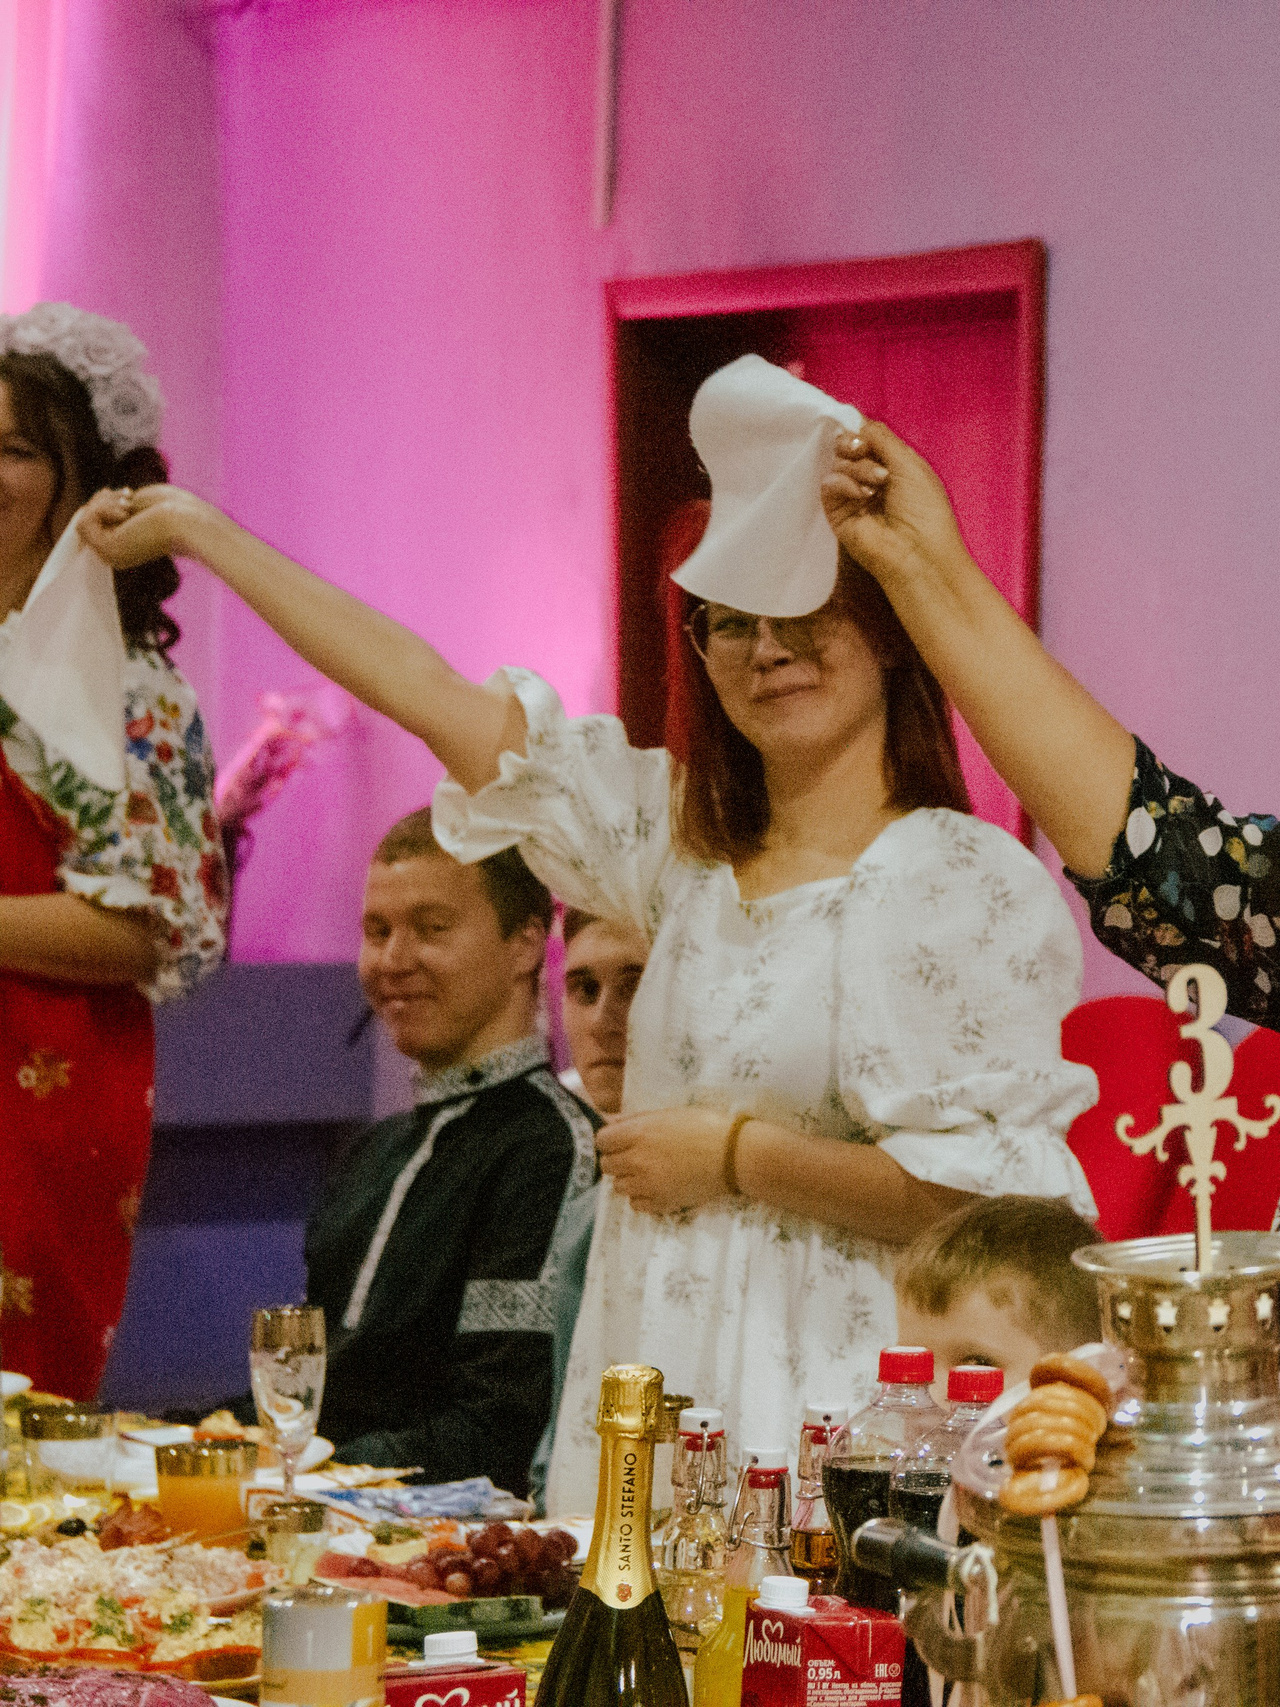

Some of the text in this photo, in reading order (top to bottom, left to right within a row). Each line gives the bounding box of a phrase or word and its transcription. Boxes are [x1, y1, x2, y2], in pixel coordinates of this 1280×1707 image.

[1166, 963, 1234, 1101] 3
[618, 1453, 637, 1571] SANTO STEFANO
[743, 1618, 801, 1668] Любимый
